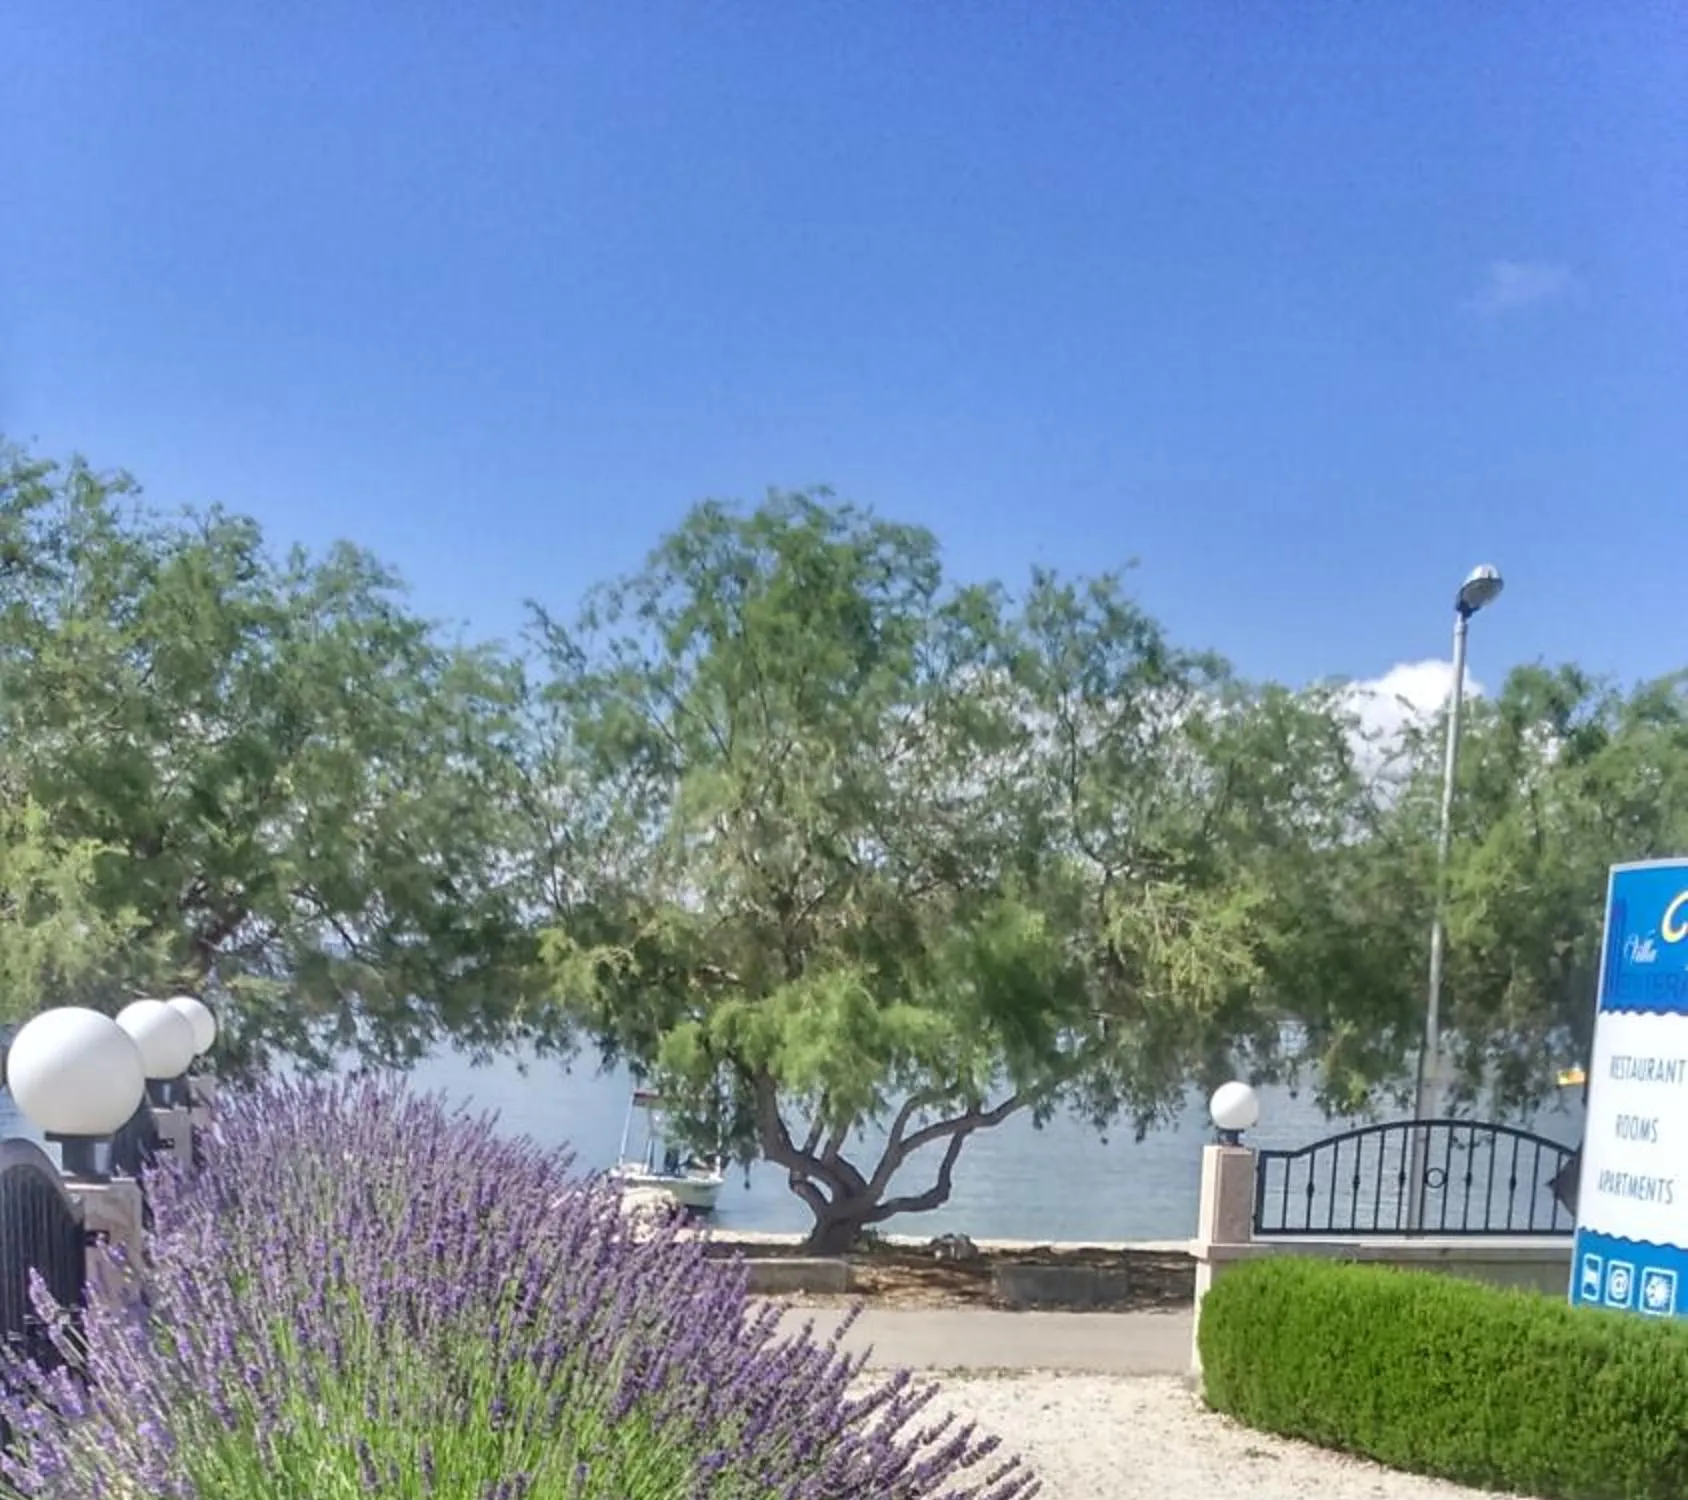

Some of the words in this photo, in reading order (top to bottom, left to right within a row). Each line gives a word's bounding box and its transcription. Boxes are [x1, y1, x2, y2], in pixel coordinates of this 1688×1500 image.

[1609, 1055, 1687, 1084] RESTAURANT
[1615, 1113, 1660, 1144] ROOMS
[1597, 1168, 1675, 1205] APARTMENTS
